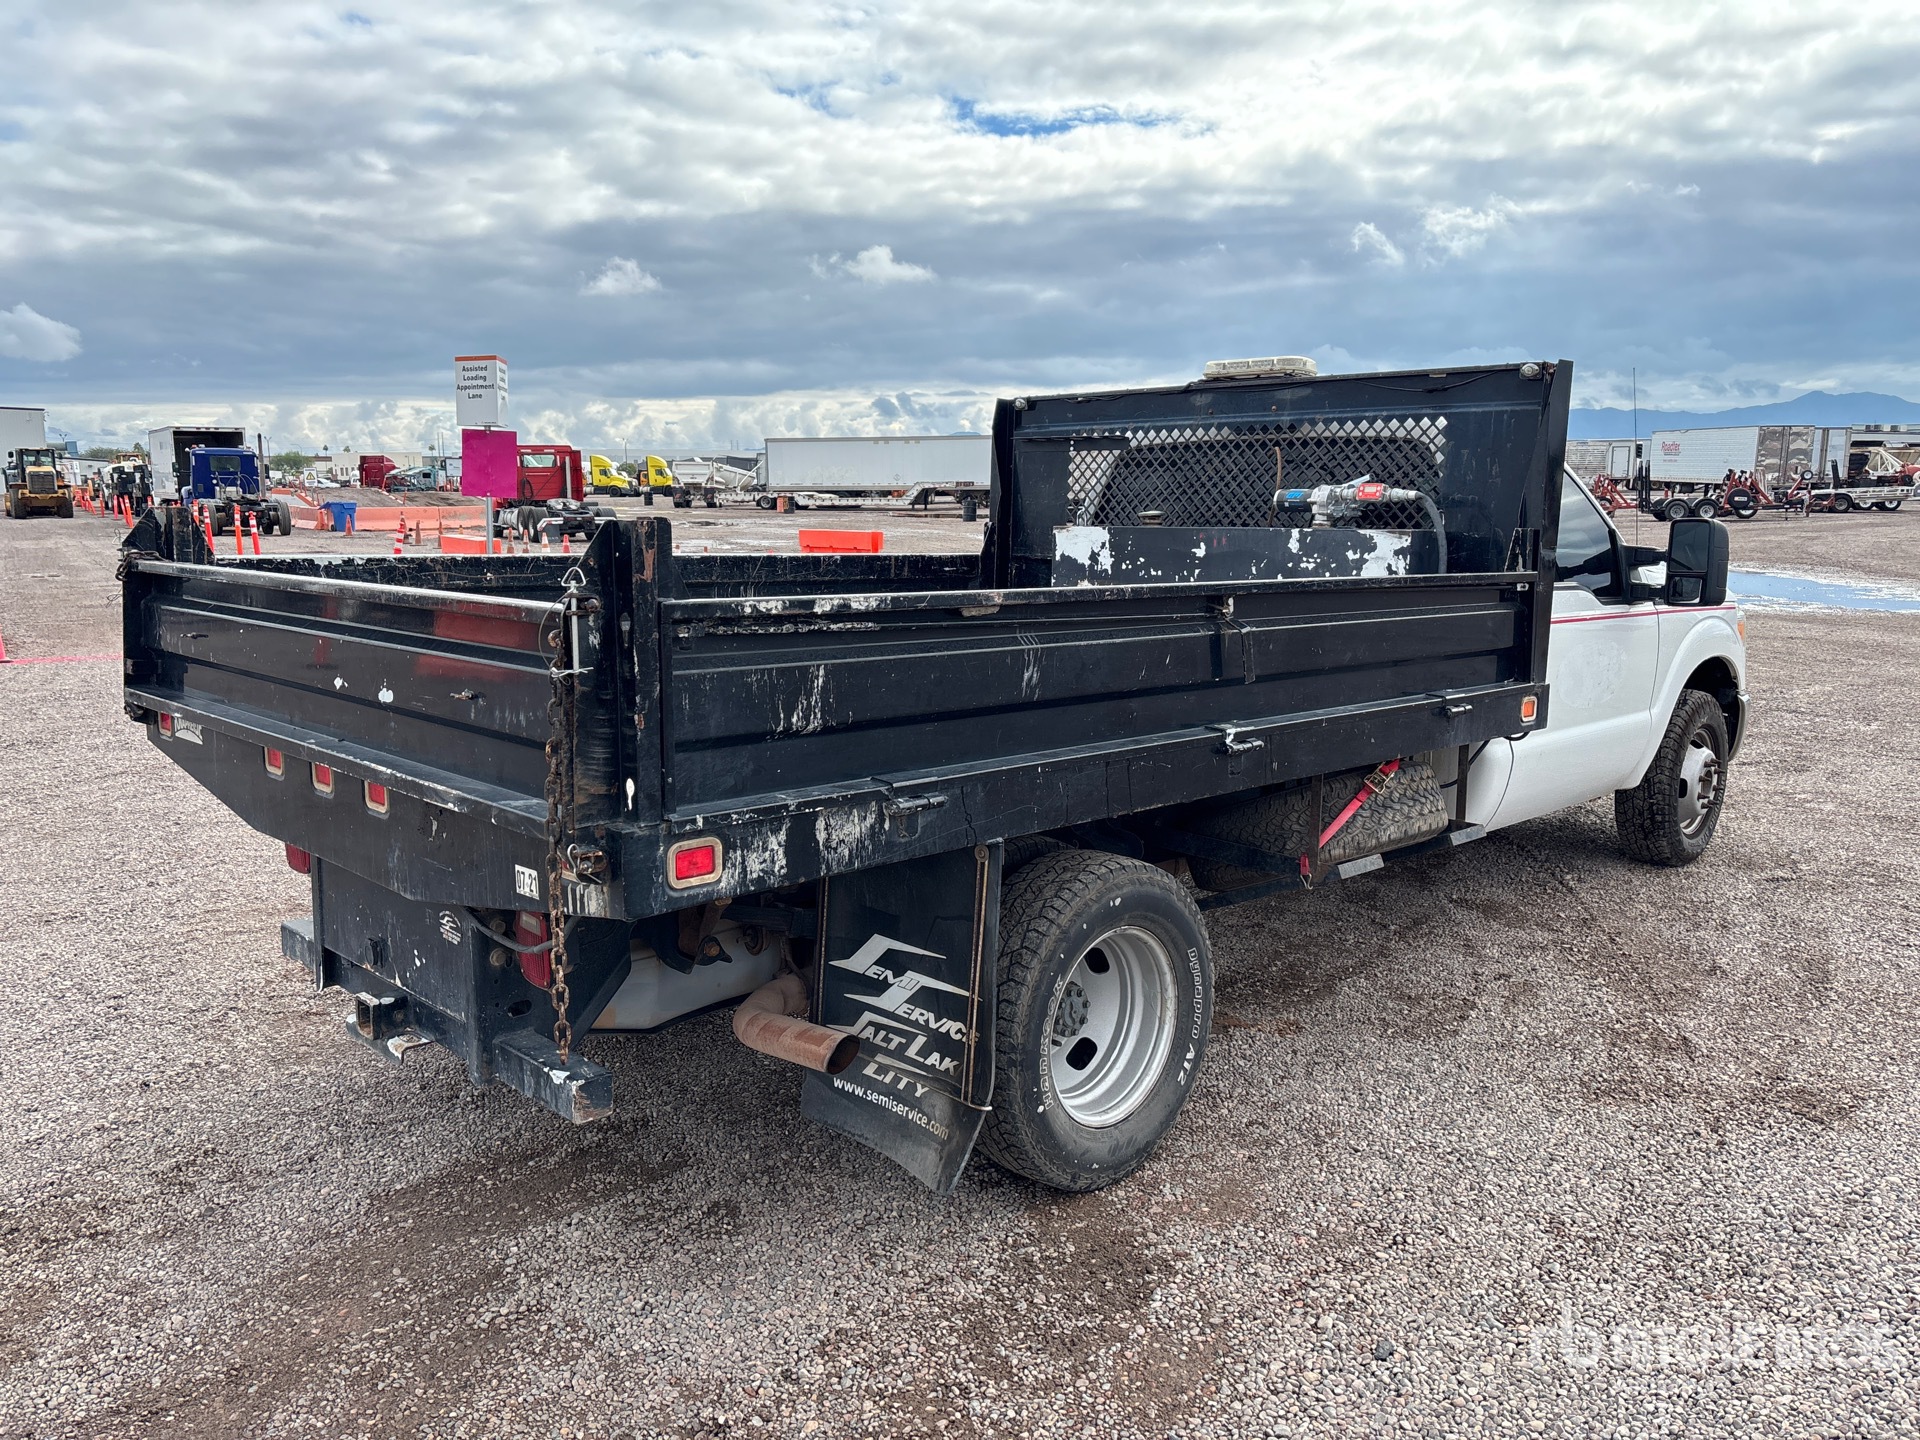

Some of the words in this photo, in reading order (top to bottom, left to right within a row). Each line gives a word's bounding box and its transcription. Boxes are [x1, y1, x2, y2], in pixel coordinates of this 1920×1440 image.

[463, 374, 487, 382] Loading
[456, 384, 495, 392] Appointment
[833, 1076, 949, 1141] www.semiservice.com
